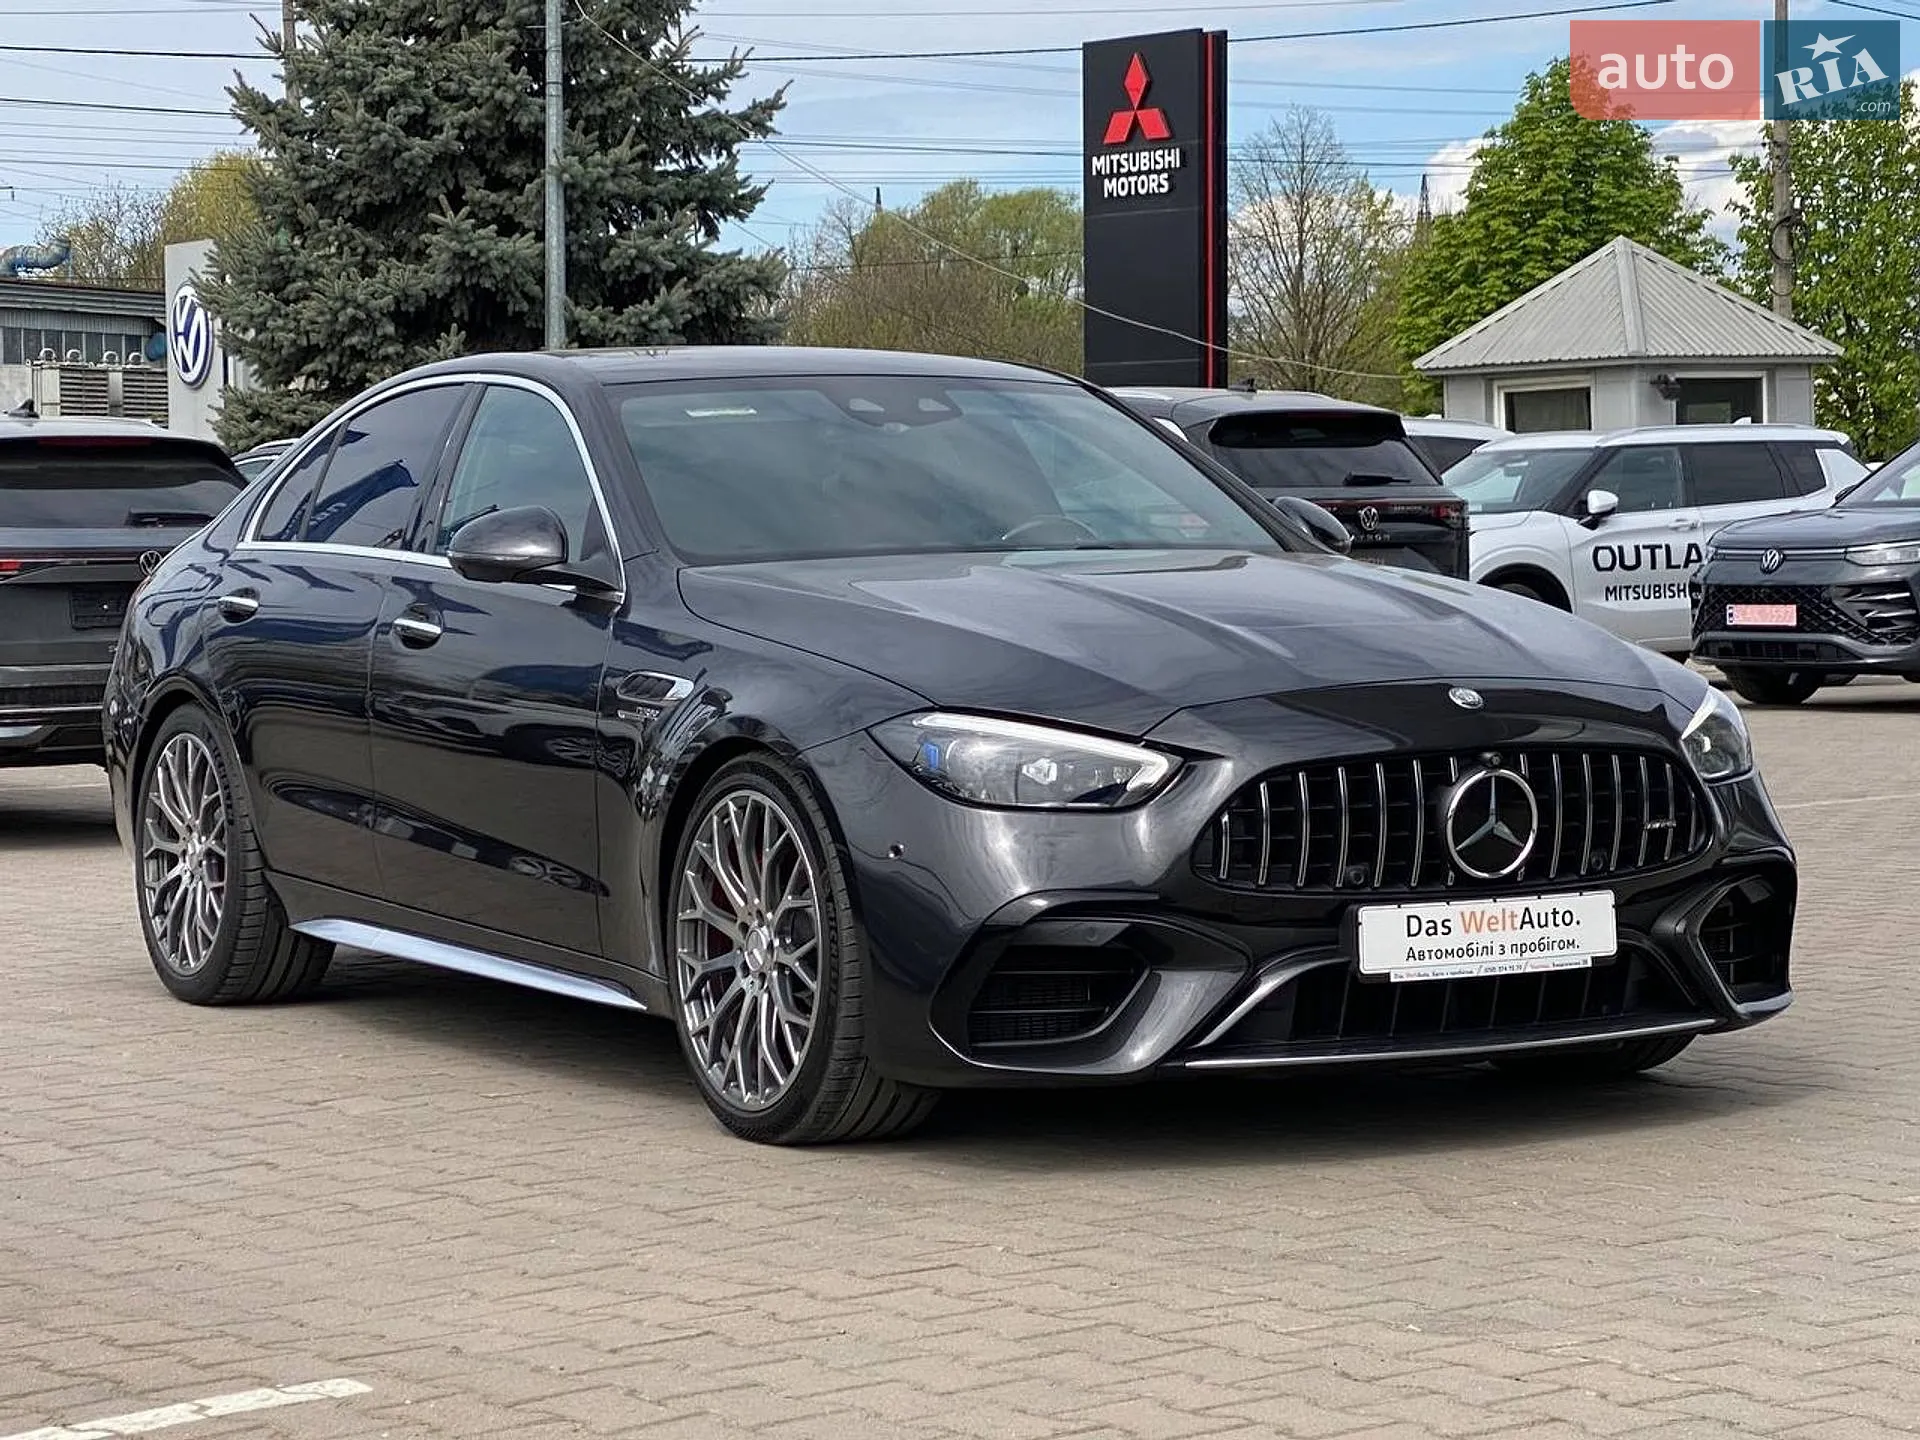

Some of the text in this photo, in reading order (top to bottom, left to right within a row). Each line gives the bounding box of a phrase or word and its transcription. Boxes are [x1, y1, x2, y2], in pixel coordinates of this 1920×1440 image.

[1091, 147, 1181, 176] MITSUBISHI
[1103, 172, 1170, 198] MOTORS
[1592, 542, 1703, 572] OUTLA
[1605, 583, 1689, 601] MITSUBISH
[1406, 914, 1452, 937] Das
[1406, 936, 1580, 961] Автомобілі з пробігом.
